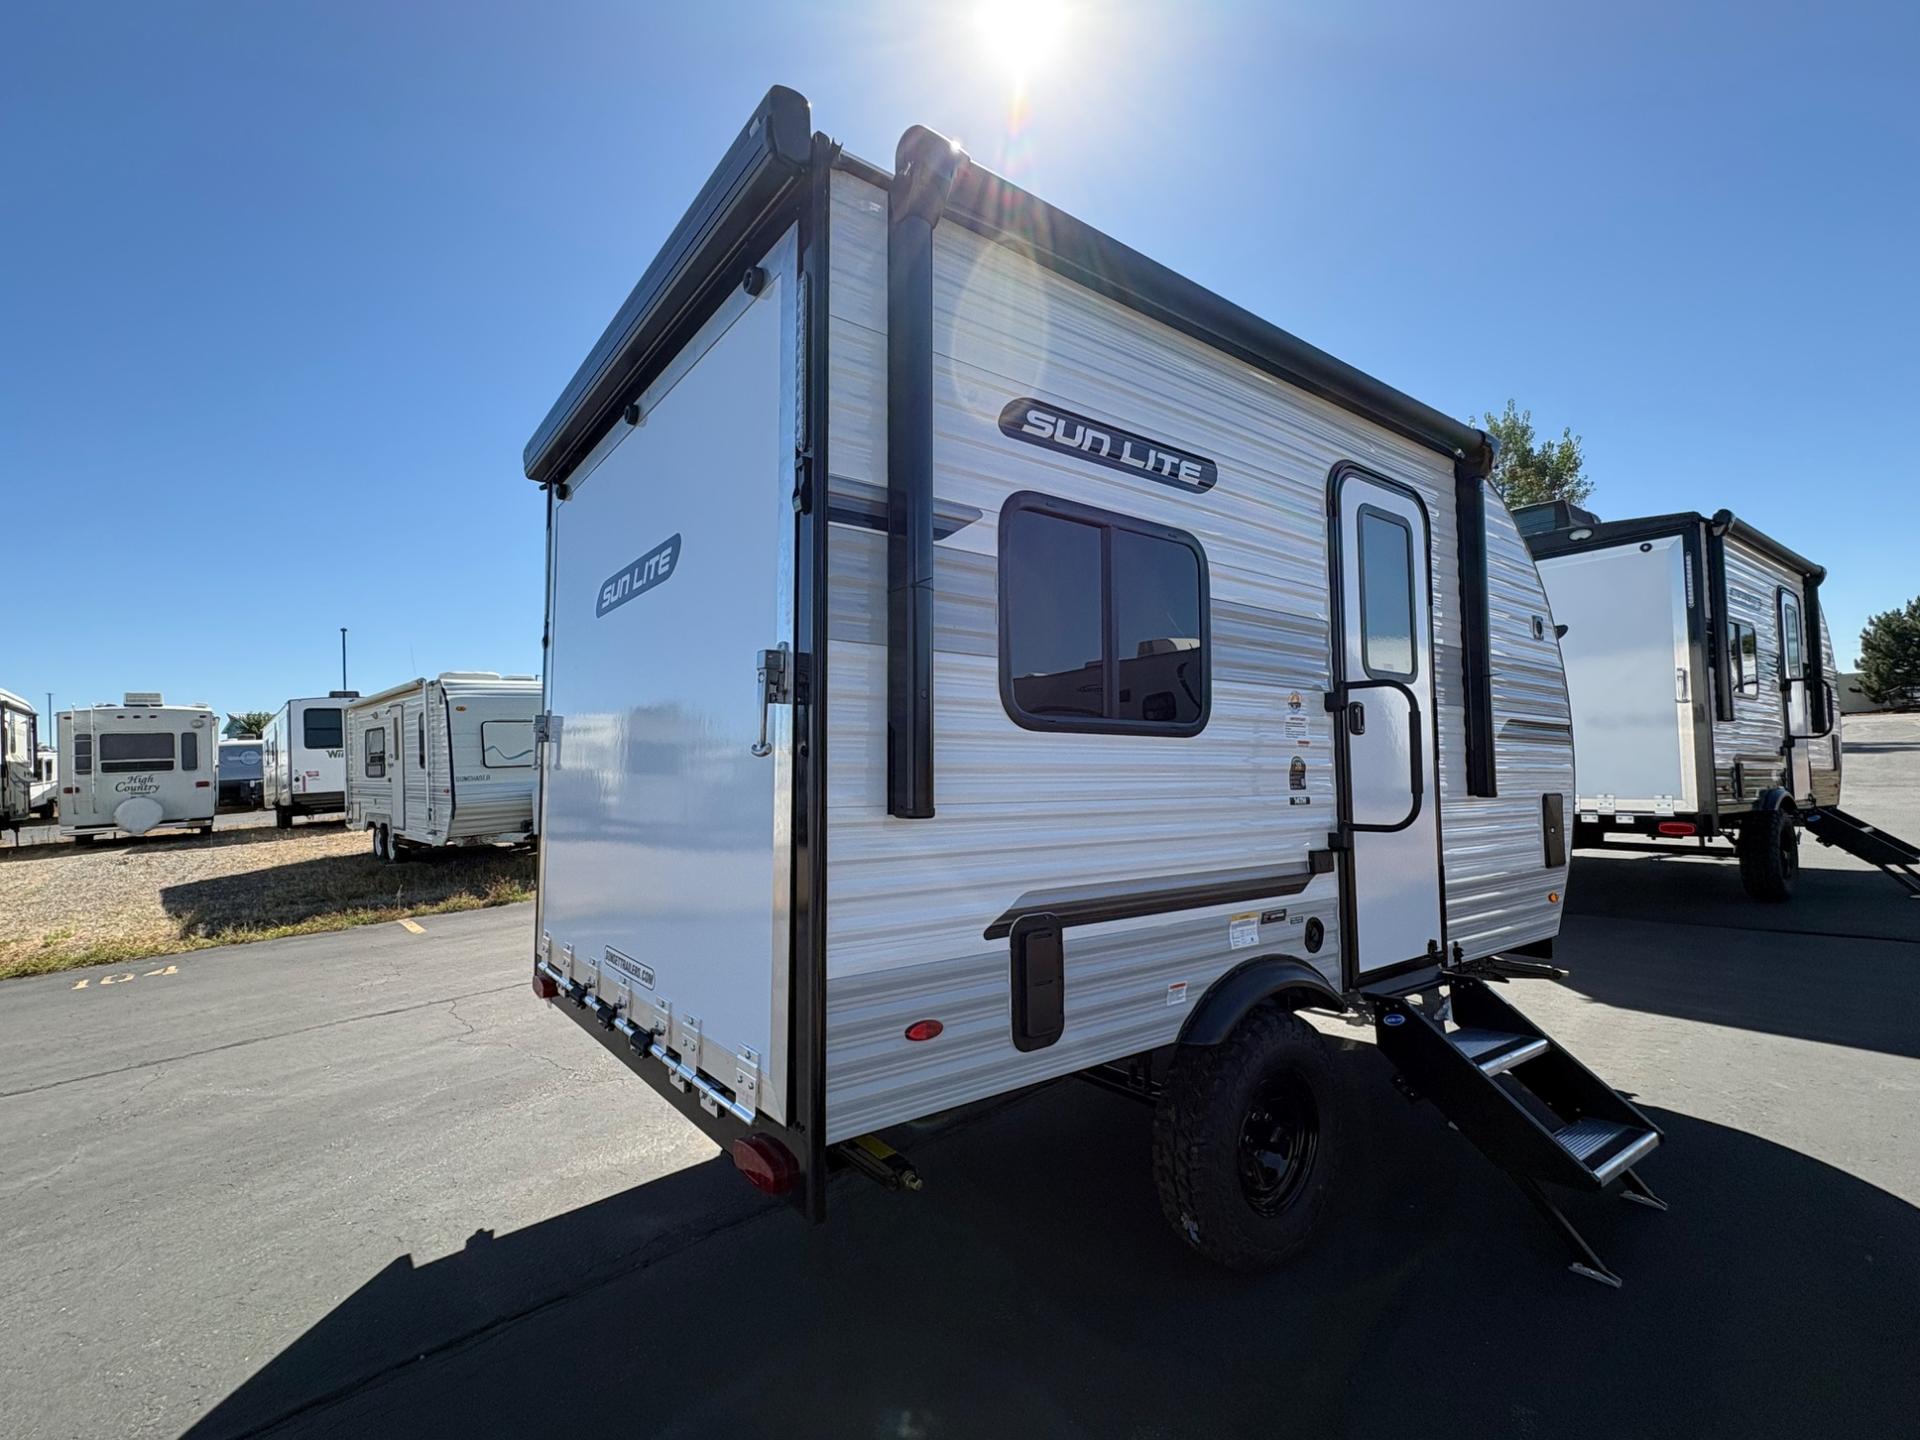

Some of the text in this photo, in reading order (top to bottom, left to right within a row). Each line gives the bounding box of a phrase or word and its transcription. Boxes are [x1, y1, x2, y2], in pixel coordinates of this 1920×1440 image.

[1021, 409, 1202, 487] SUN LITE
[601, 546, 673, 609] SUN LITE
[115, 781, 160, 793] Country
[127, 774, 154, 786] High
